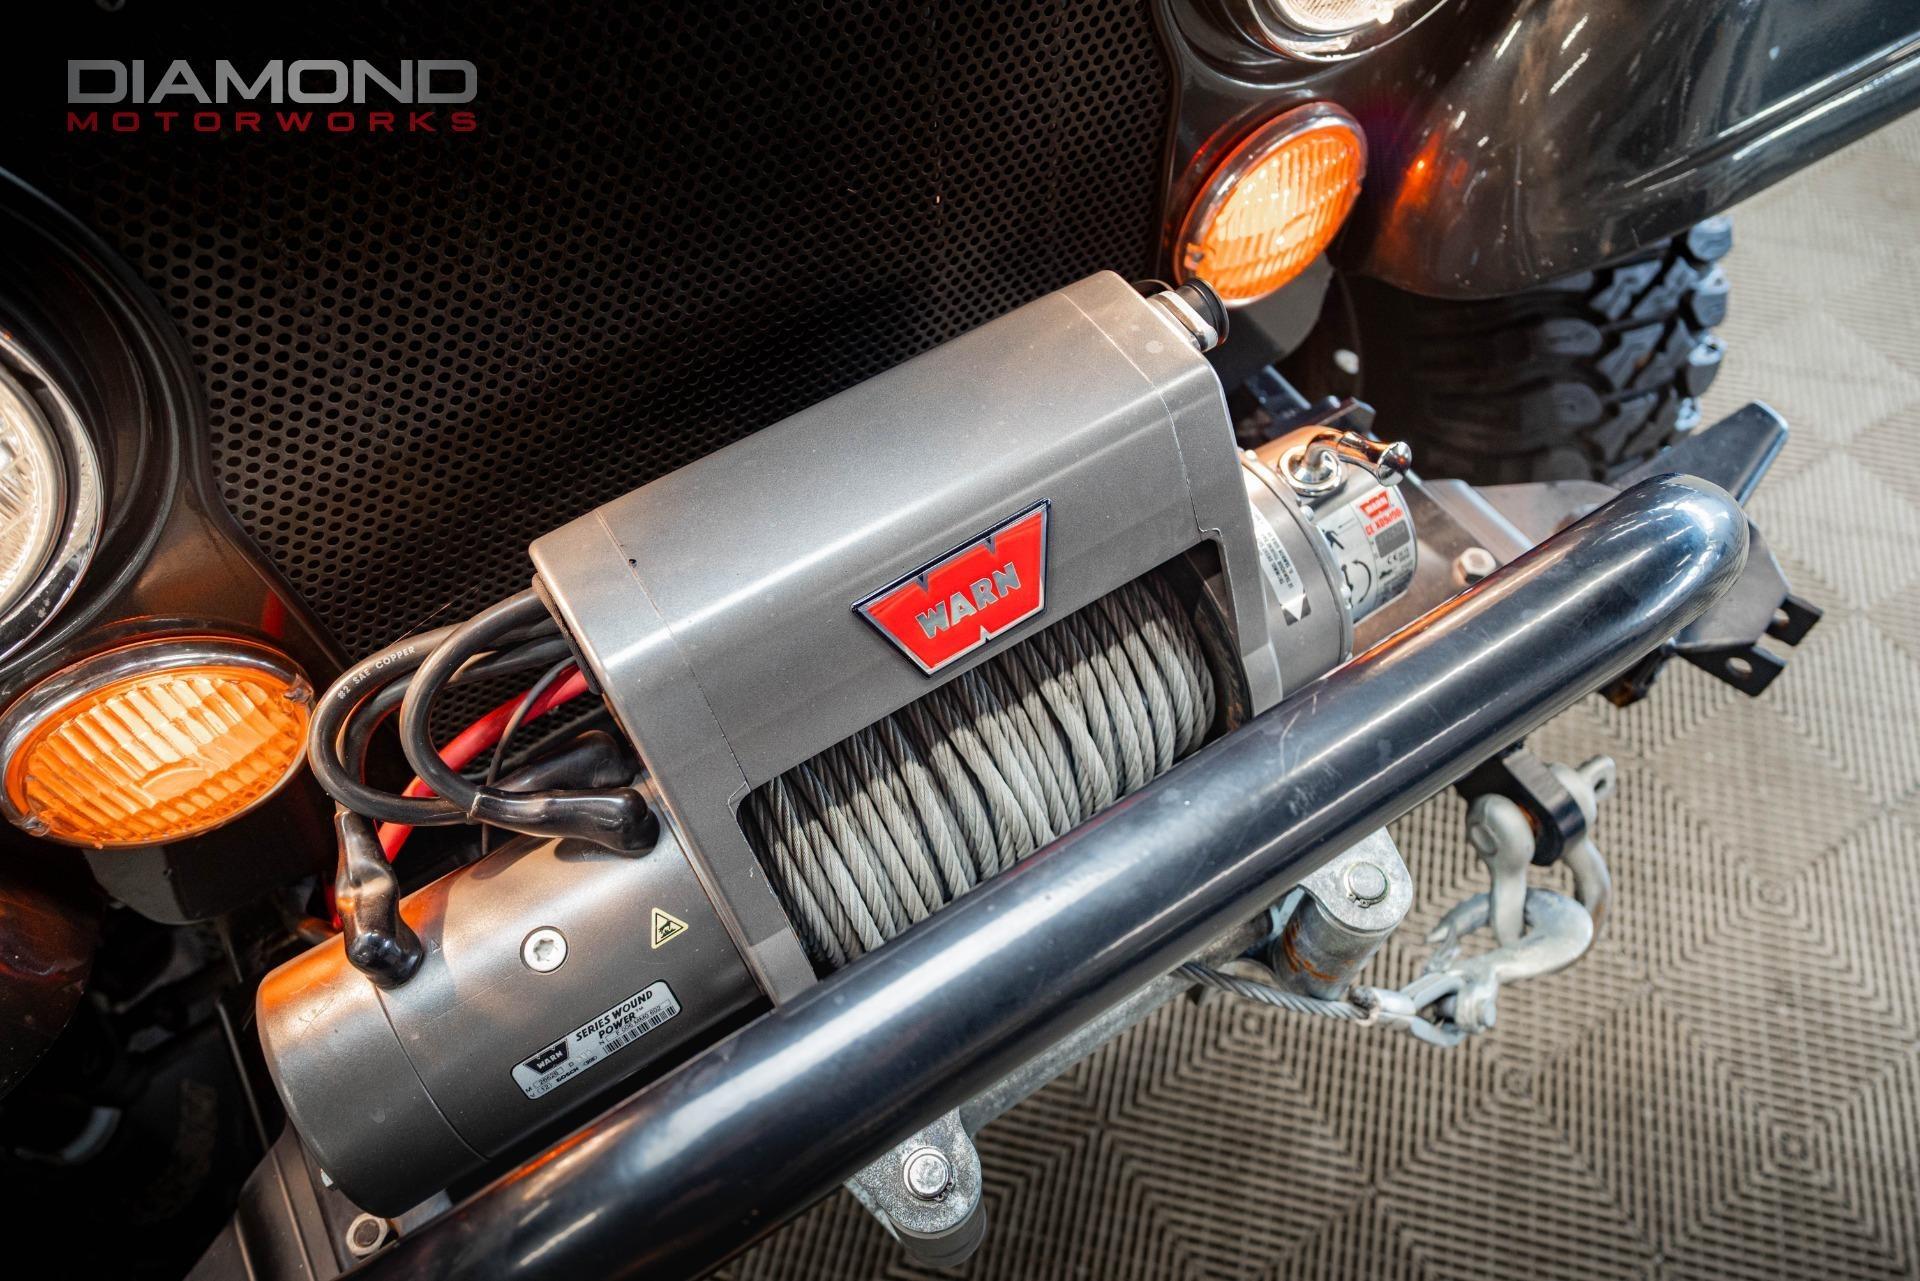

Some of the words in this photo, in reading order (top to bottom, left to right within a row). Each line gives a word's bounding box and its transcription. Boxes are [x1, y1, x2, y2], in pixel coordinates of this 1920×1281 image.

[915, 561, 1022, 640] WARN
[337, 685, 351, 700] #2
[352, 668, 371, 685] SAE
[375, 646, 416, 669] COPPER
[576, 1015, 610, 1041] SERIES
[611, 990, 653, 1019] WOUND
[598, 1012, 636, 1039] POWER
[536, 1050, 564, 1069] WARN
[556, 1067, 579, 1082] BOSCH
